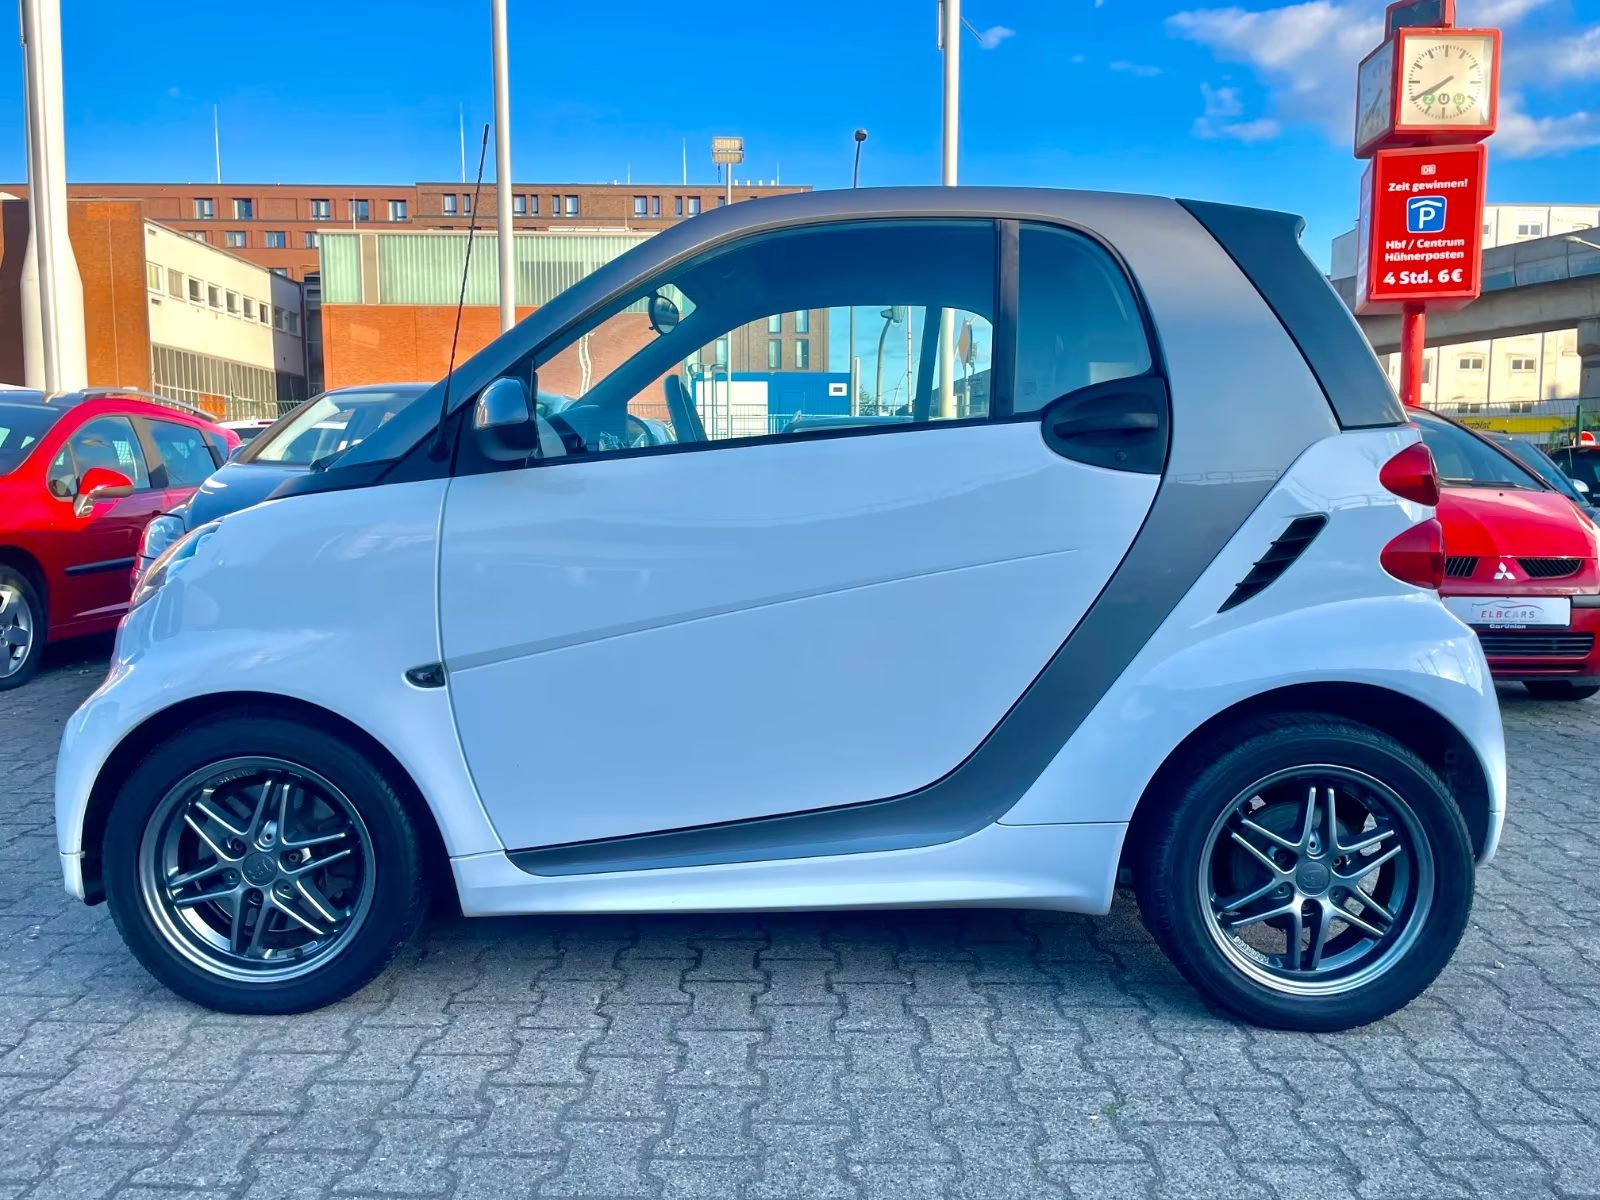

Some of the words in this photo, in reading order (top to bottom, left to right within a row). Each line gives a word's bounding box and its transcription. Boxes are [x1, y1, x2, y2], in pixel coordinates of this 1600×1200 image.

[1388, 182, 1410, 192] Zeit
[1412, 178, 1468, 192] gewinnen!
[1419, 207, 1435, 229] P
[1385, 240, 1406, 249] Hbf
[1416, 238, 1465, 249] Centrum
[1385, 251, 1464, 262] Hühnerposten
[1383, 271, 1397, 285] 4
[1399, 269, 1434, 285] Std.
